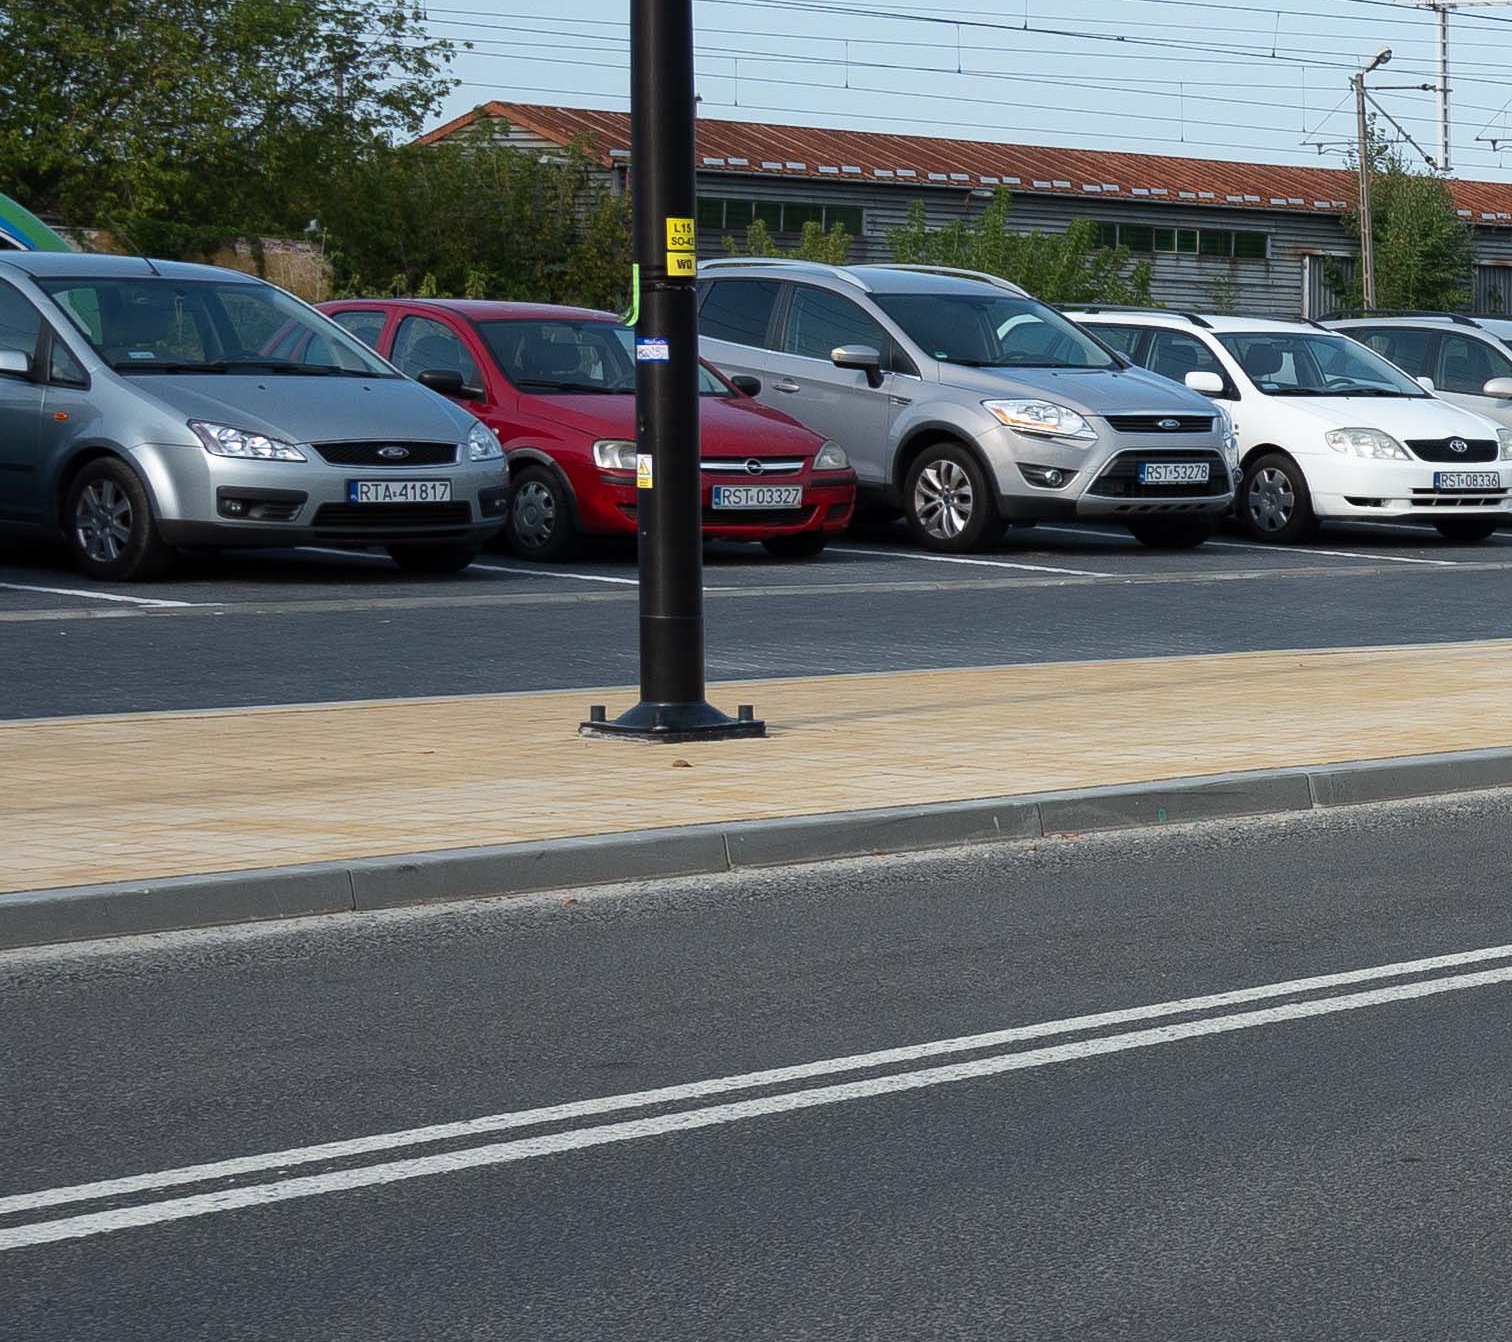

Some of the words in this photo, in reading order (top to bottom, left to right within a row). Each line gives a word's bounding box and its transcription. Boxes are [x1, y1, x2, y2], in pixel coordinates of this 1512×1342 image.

[1146, 465, 1170, 480] RST
[1173, 465, 1207, 480] 53278
[1441, 474, 1462, 487] RST
[359, 483, 393, 500] RTA
[398, 483, 449, 500] 41817
[722, 488, 752, 504] RST
[756, 488, 800, 504] 03327
